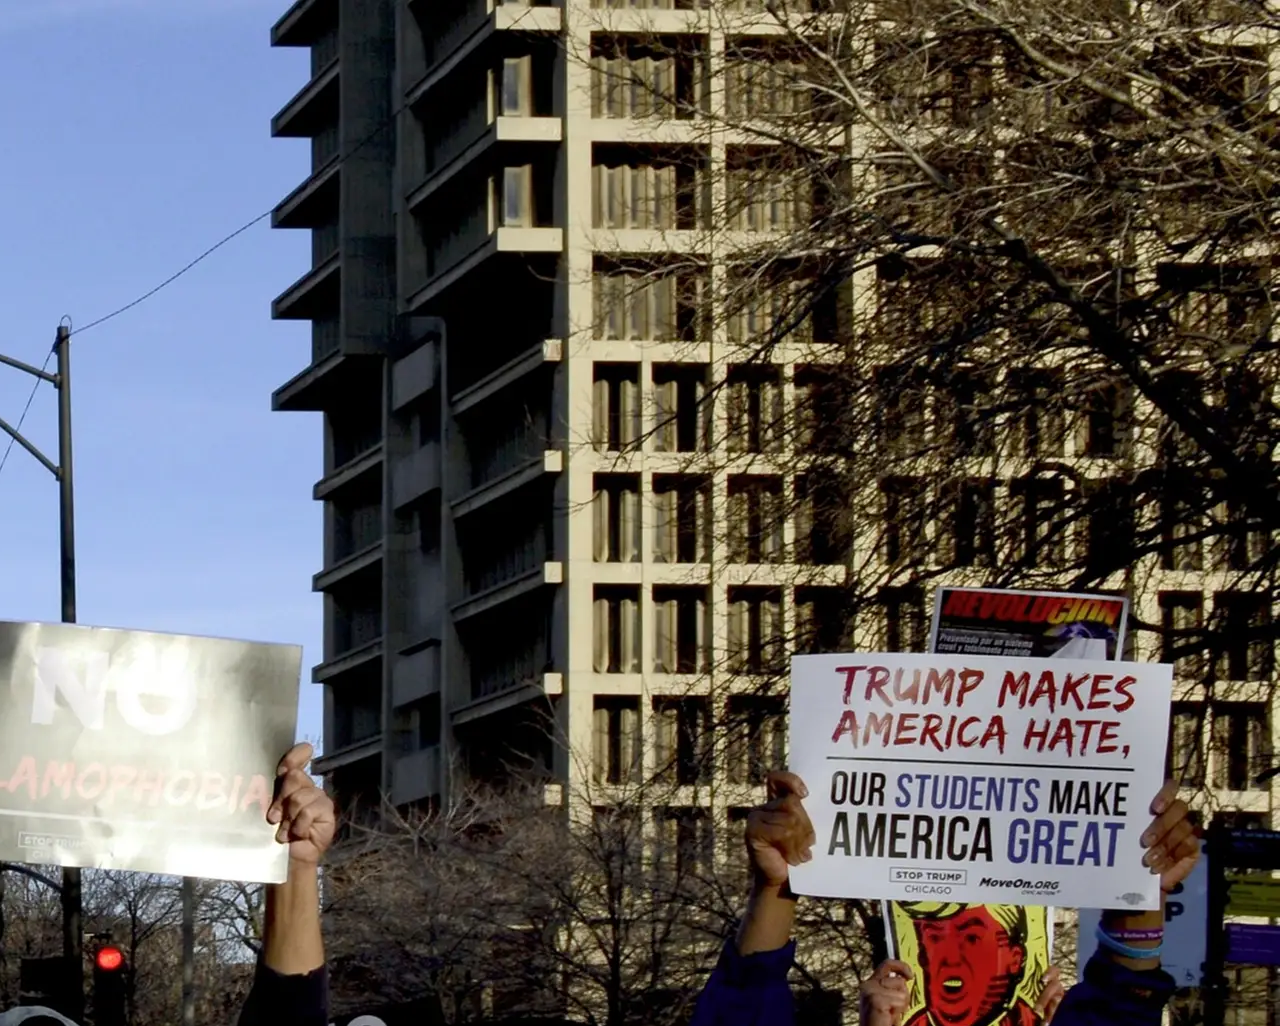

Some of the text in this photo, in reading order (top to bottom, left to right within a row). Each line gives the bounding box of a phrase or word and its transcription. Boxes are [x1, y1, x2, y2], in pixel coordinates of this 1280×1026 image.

[30, 643, 198, 736] NO
[835, 665, 1137, 713] TRUMP MAKES
[831, 709, 1131, 759] AMERICA HATE,
[830, 771, 1129, 817] OUR STUDENTS MAKE
[827, 812, 1125, 867] AMERICA GREAT
[896, 871, 962, 882] STOP TRUMP
[904, 885, 952, 895] CHICAGO
[979, 877, 1059, 890] MoveOn.ORG
